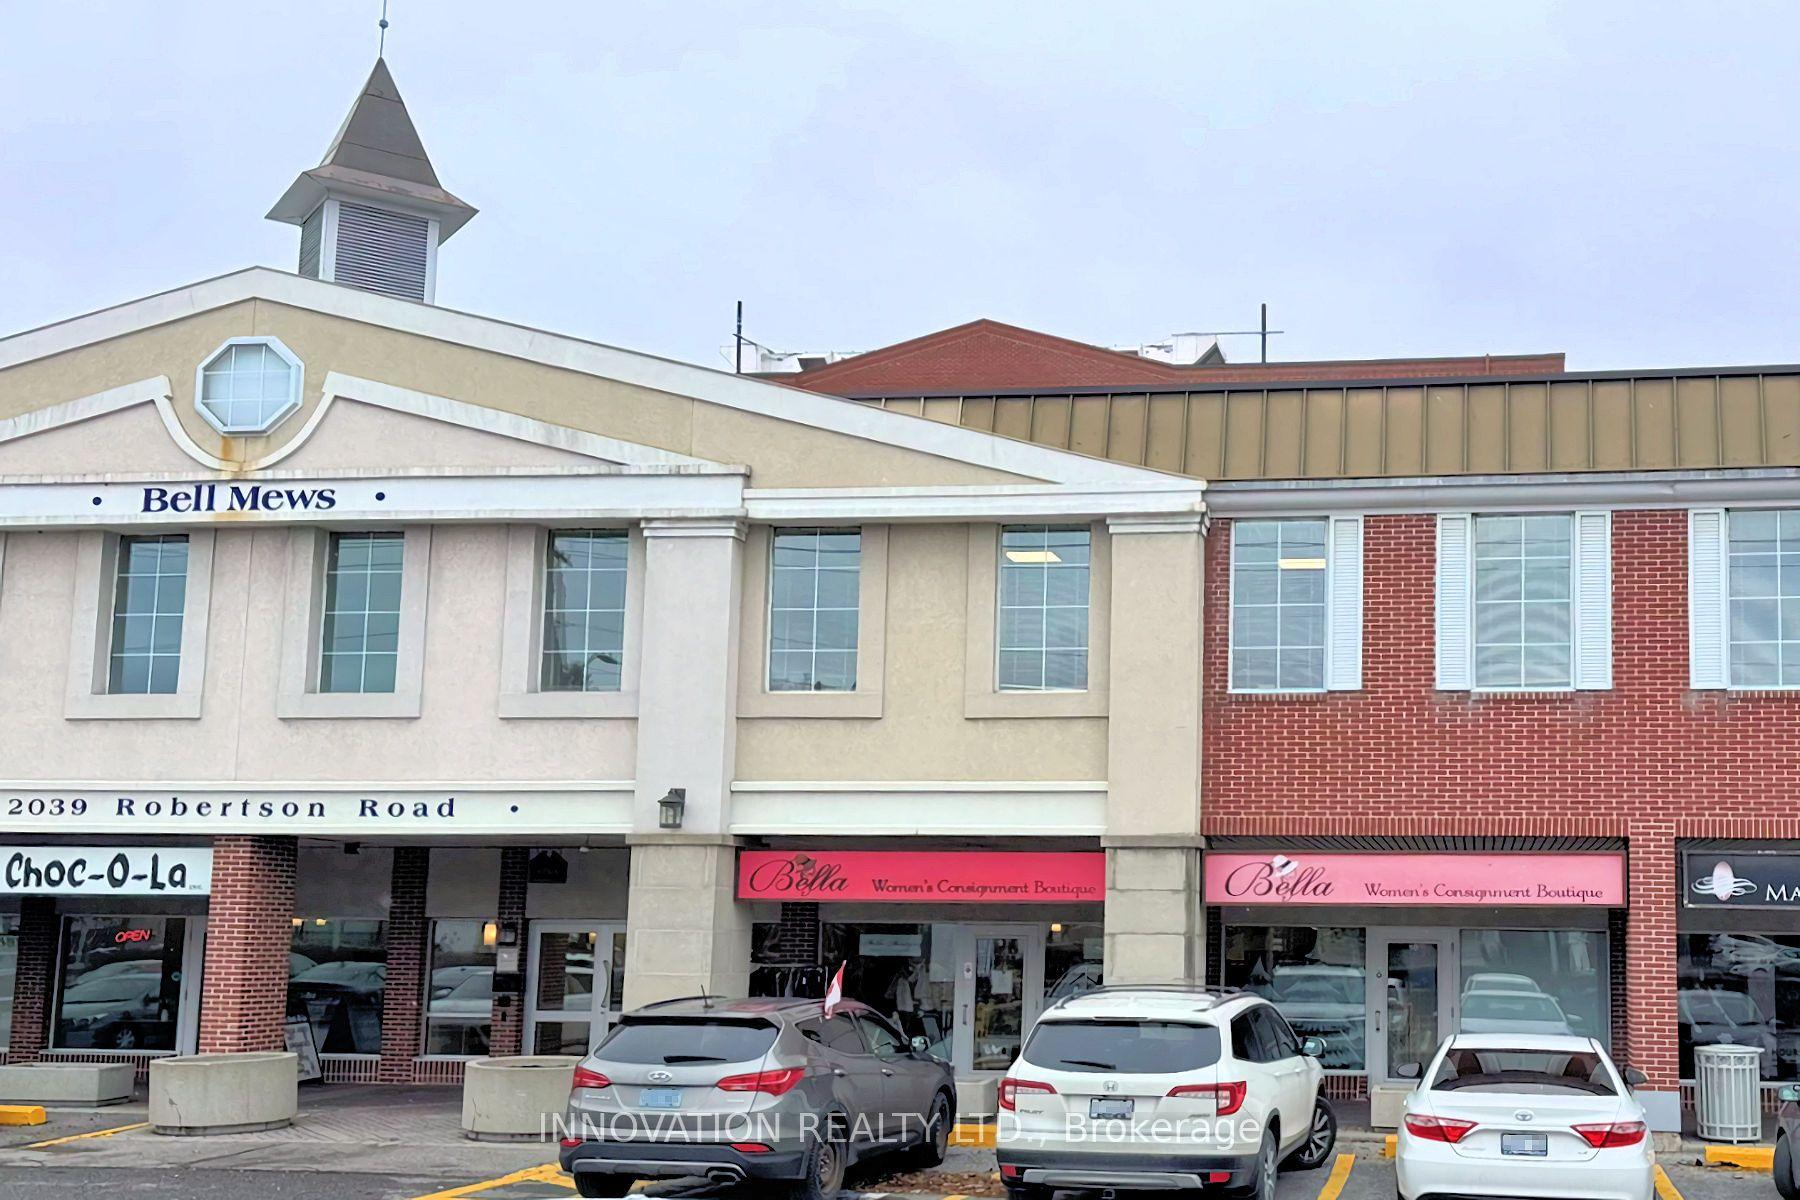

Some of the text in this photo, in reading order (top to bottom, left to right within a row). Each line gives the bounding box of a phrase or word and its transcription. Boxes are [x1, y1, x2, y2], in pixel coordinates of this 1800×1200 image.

[141, 484, 336, 512] Bell Mews
[8, 797, 456, 818] 2039 Robertson Road
[750, 859, 849, 894] Bella
[1225, 861, 1335, 898] Bella
[872, 879, 1097, 898] Women's Consignment Boutique
[1365, 882, 1604, 902] Women's Consignment Boutique
[115, 929, 151, 943] OPEN
